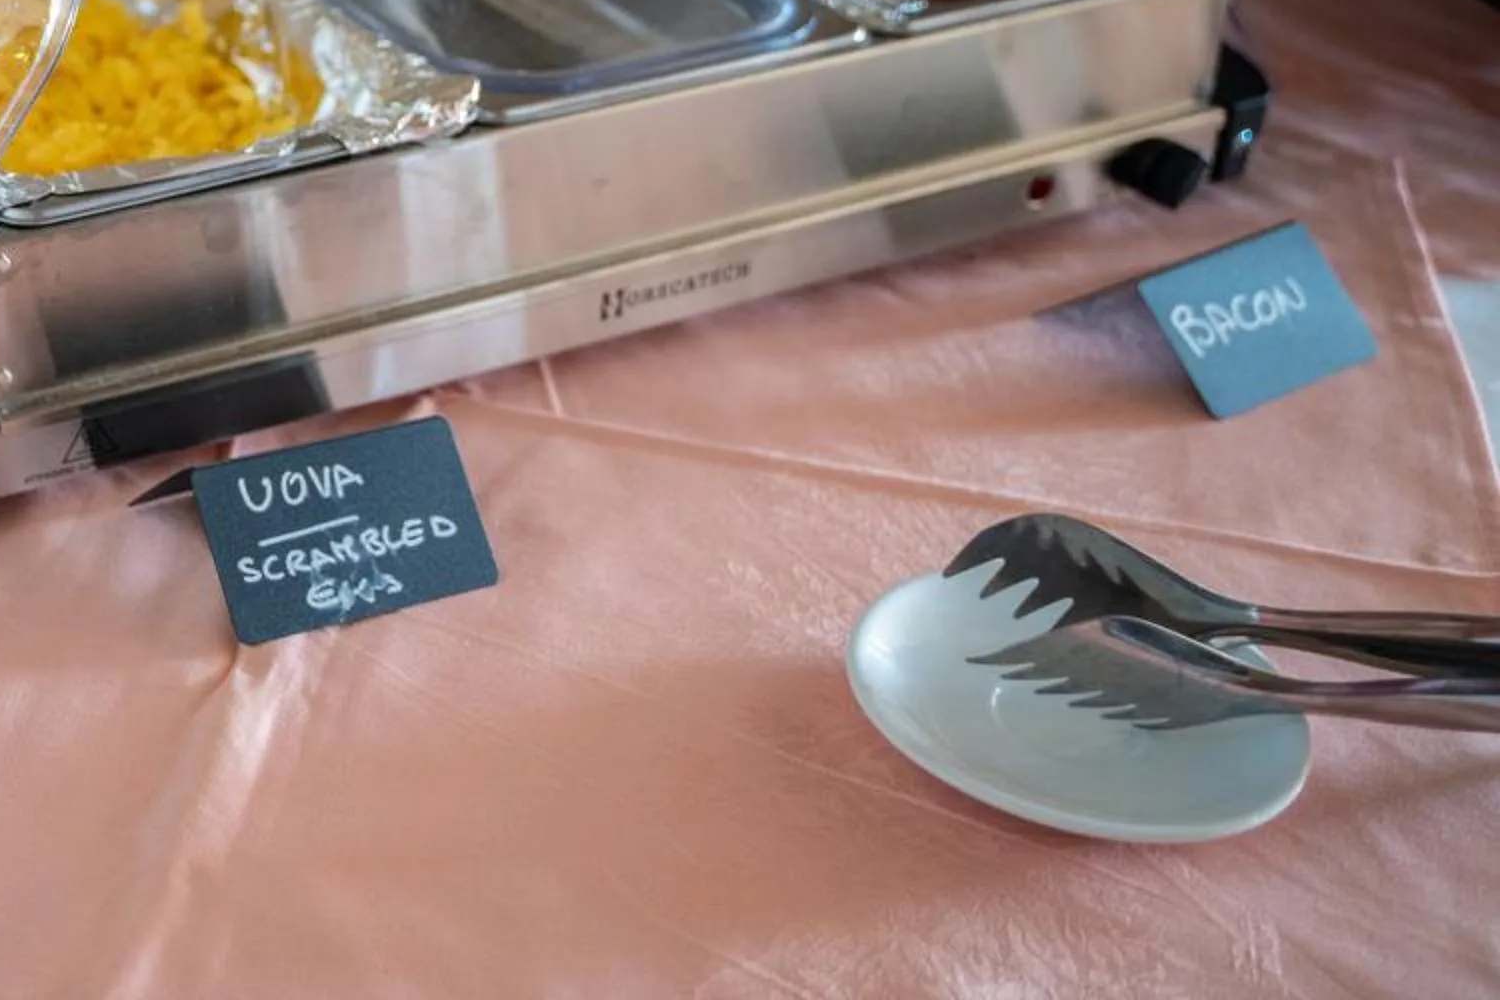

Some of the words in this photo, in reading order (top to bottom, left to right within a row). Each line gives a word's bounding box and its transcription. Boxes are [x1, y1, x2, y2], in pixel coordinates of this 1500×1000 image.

[1170, 276, 1308, 359] BACON
[238, 464, 364, 512] UOVA
[237, 515, 458, 583] SCRAMBLED
